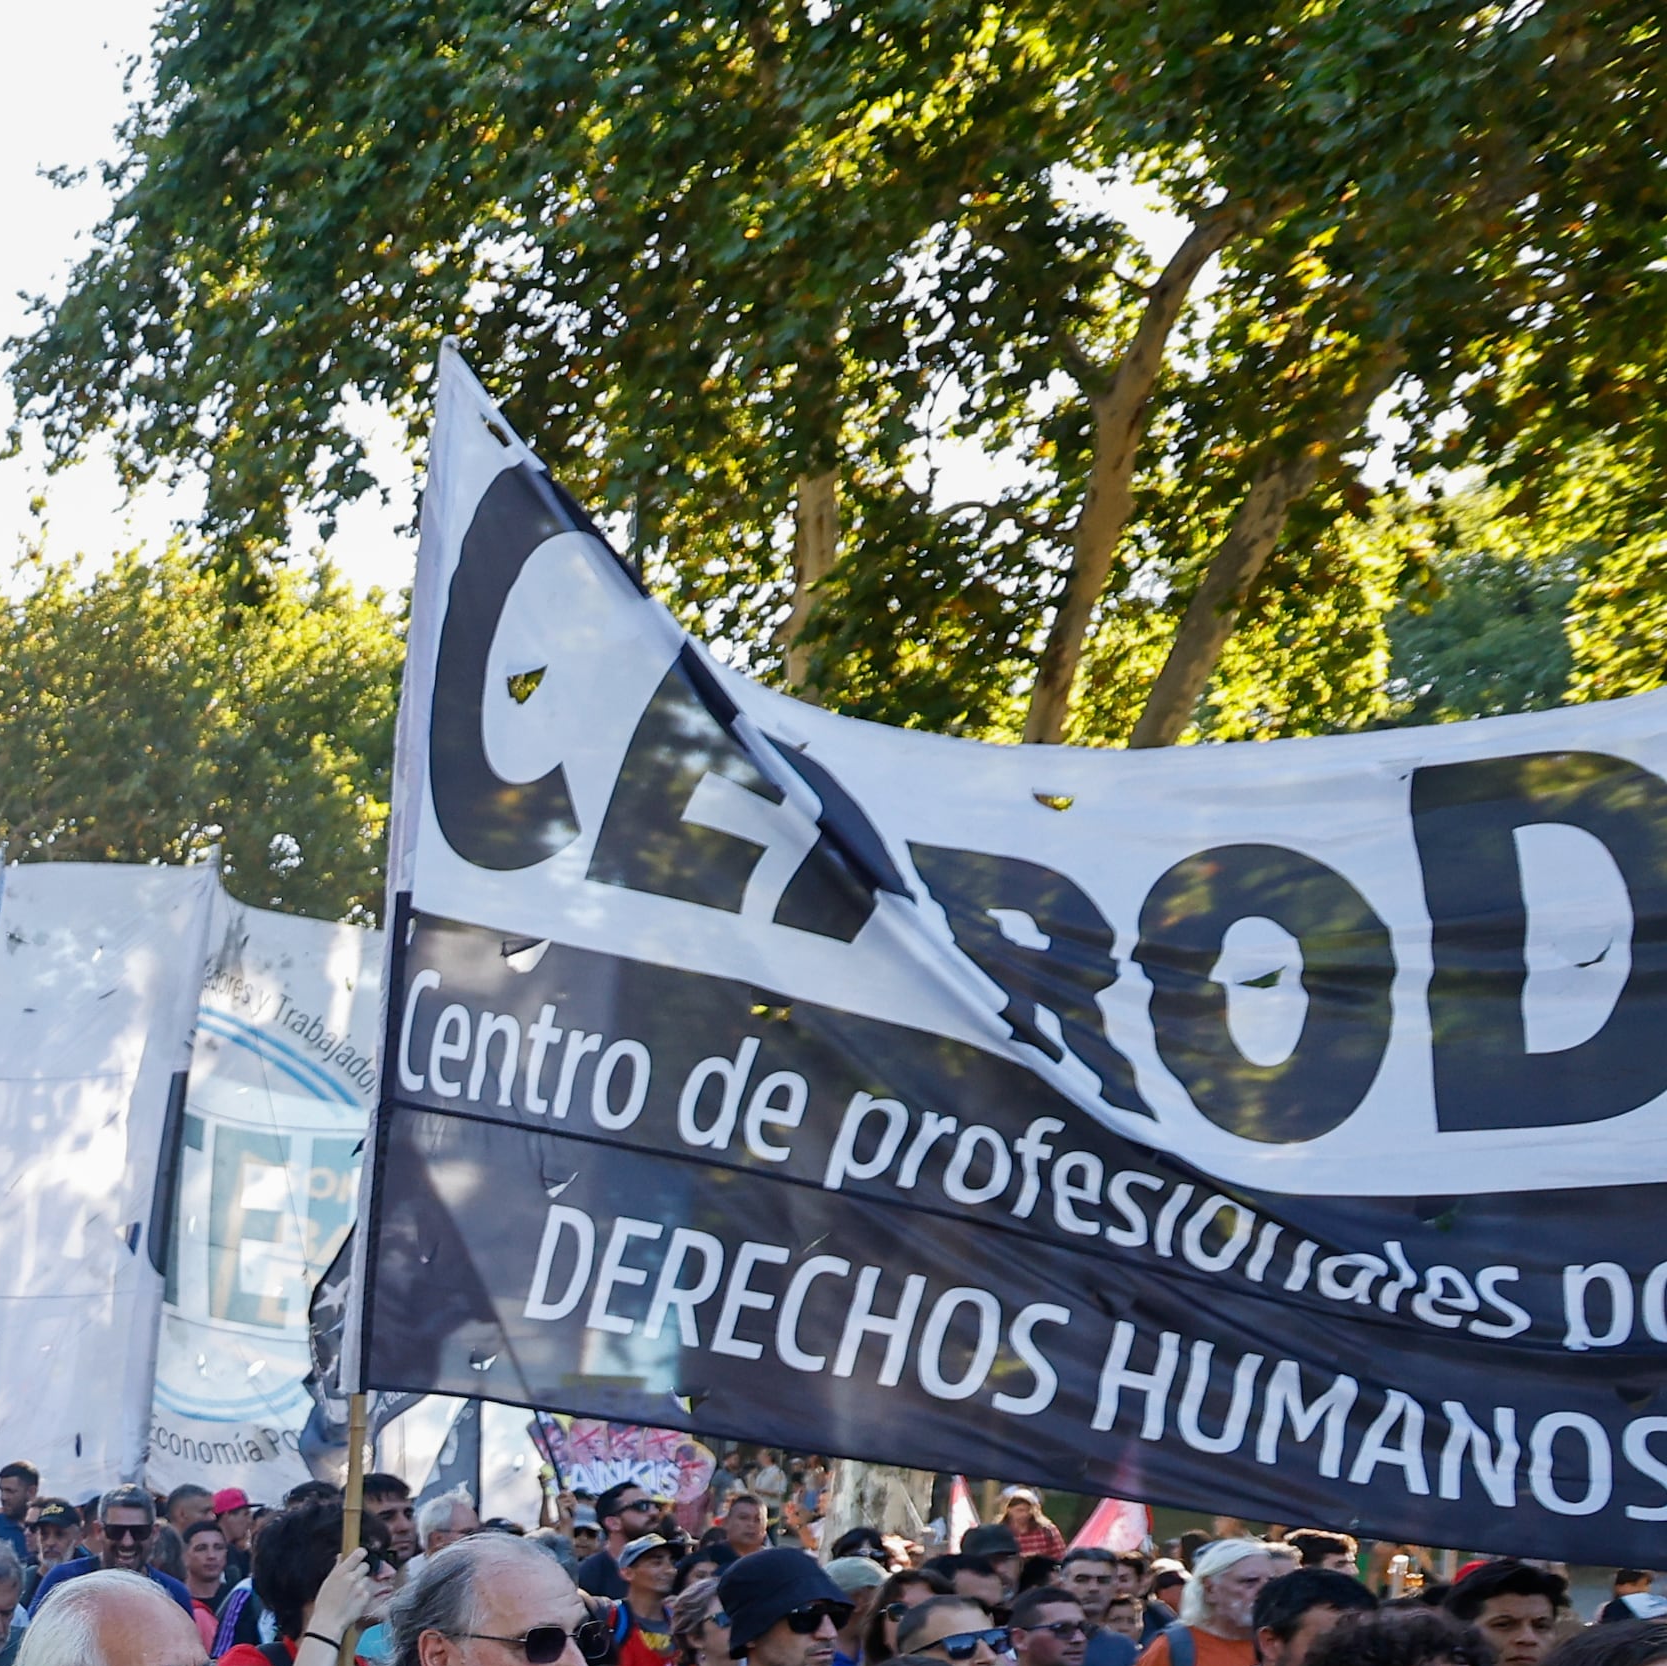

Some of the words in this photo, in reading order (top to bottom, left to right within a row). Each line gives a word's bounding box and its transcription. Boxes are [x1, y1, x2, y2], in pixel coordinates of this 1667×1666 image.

[398, 969, 651, 1131] Centro
[677, 1036, 808, 1162] de
[824, 1112, 1531, 1340] profesionales
[261, 1428, 300, 1456] Po
[523, 1204, 1070, 1416] DERECHOS
[1091, 1320, 1667, 1521] HUMANOS
